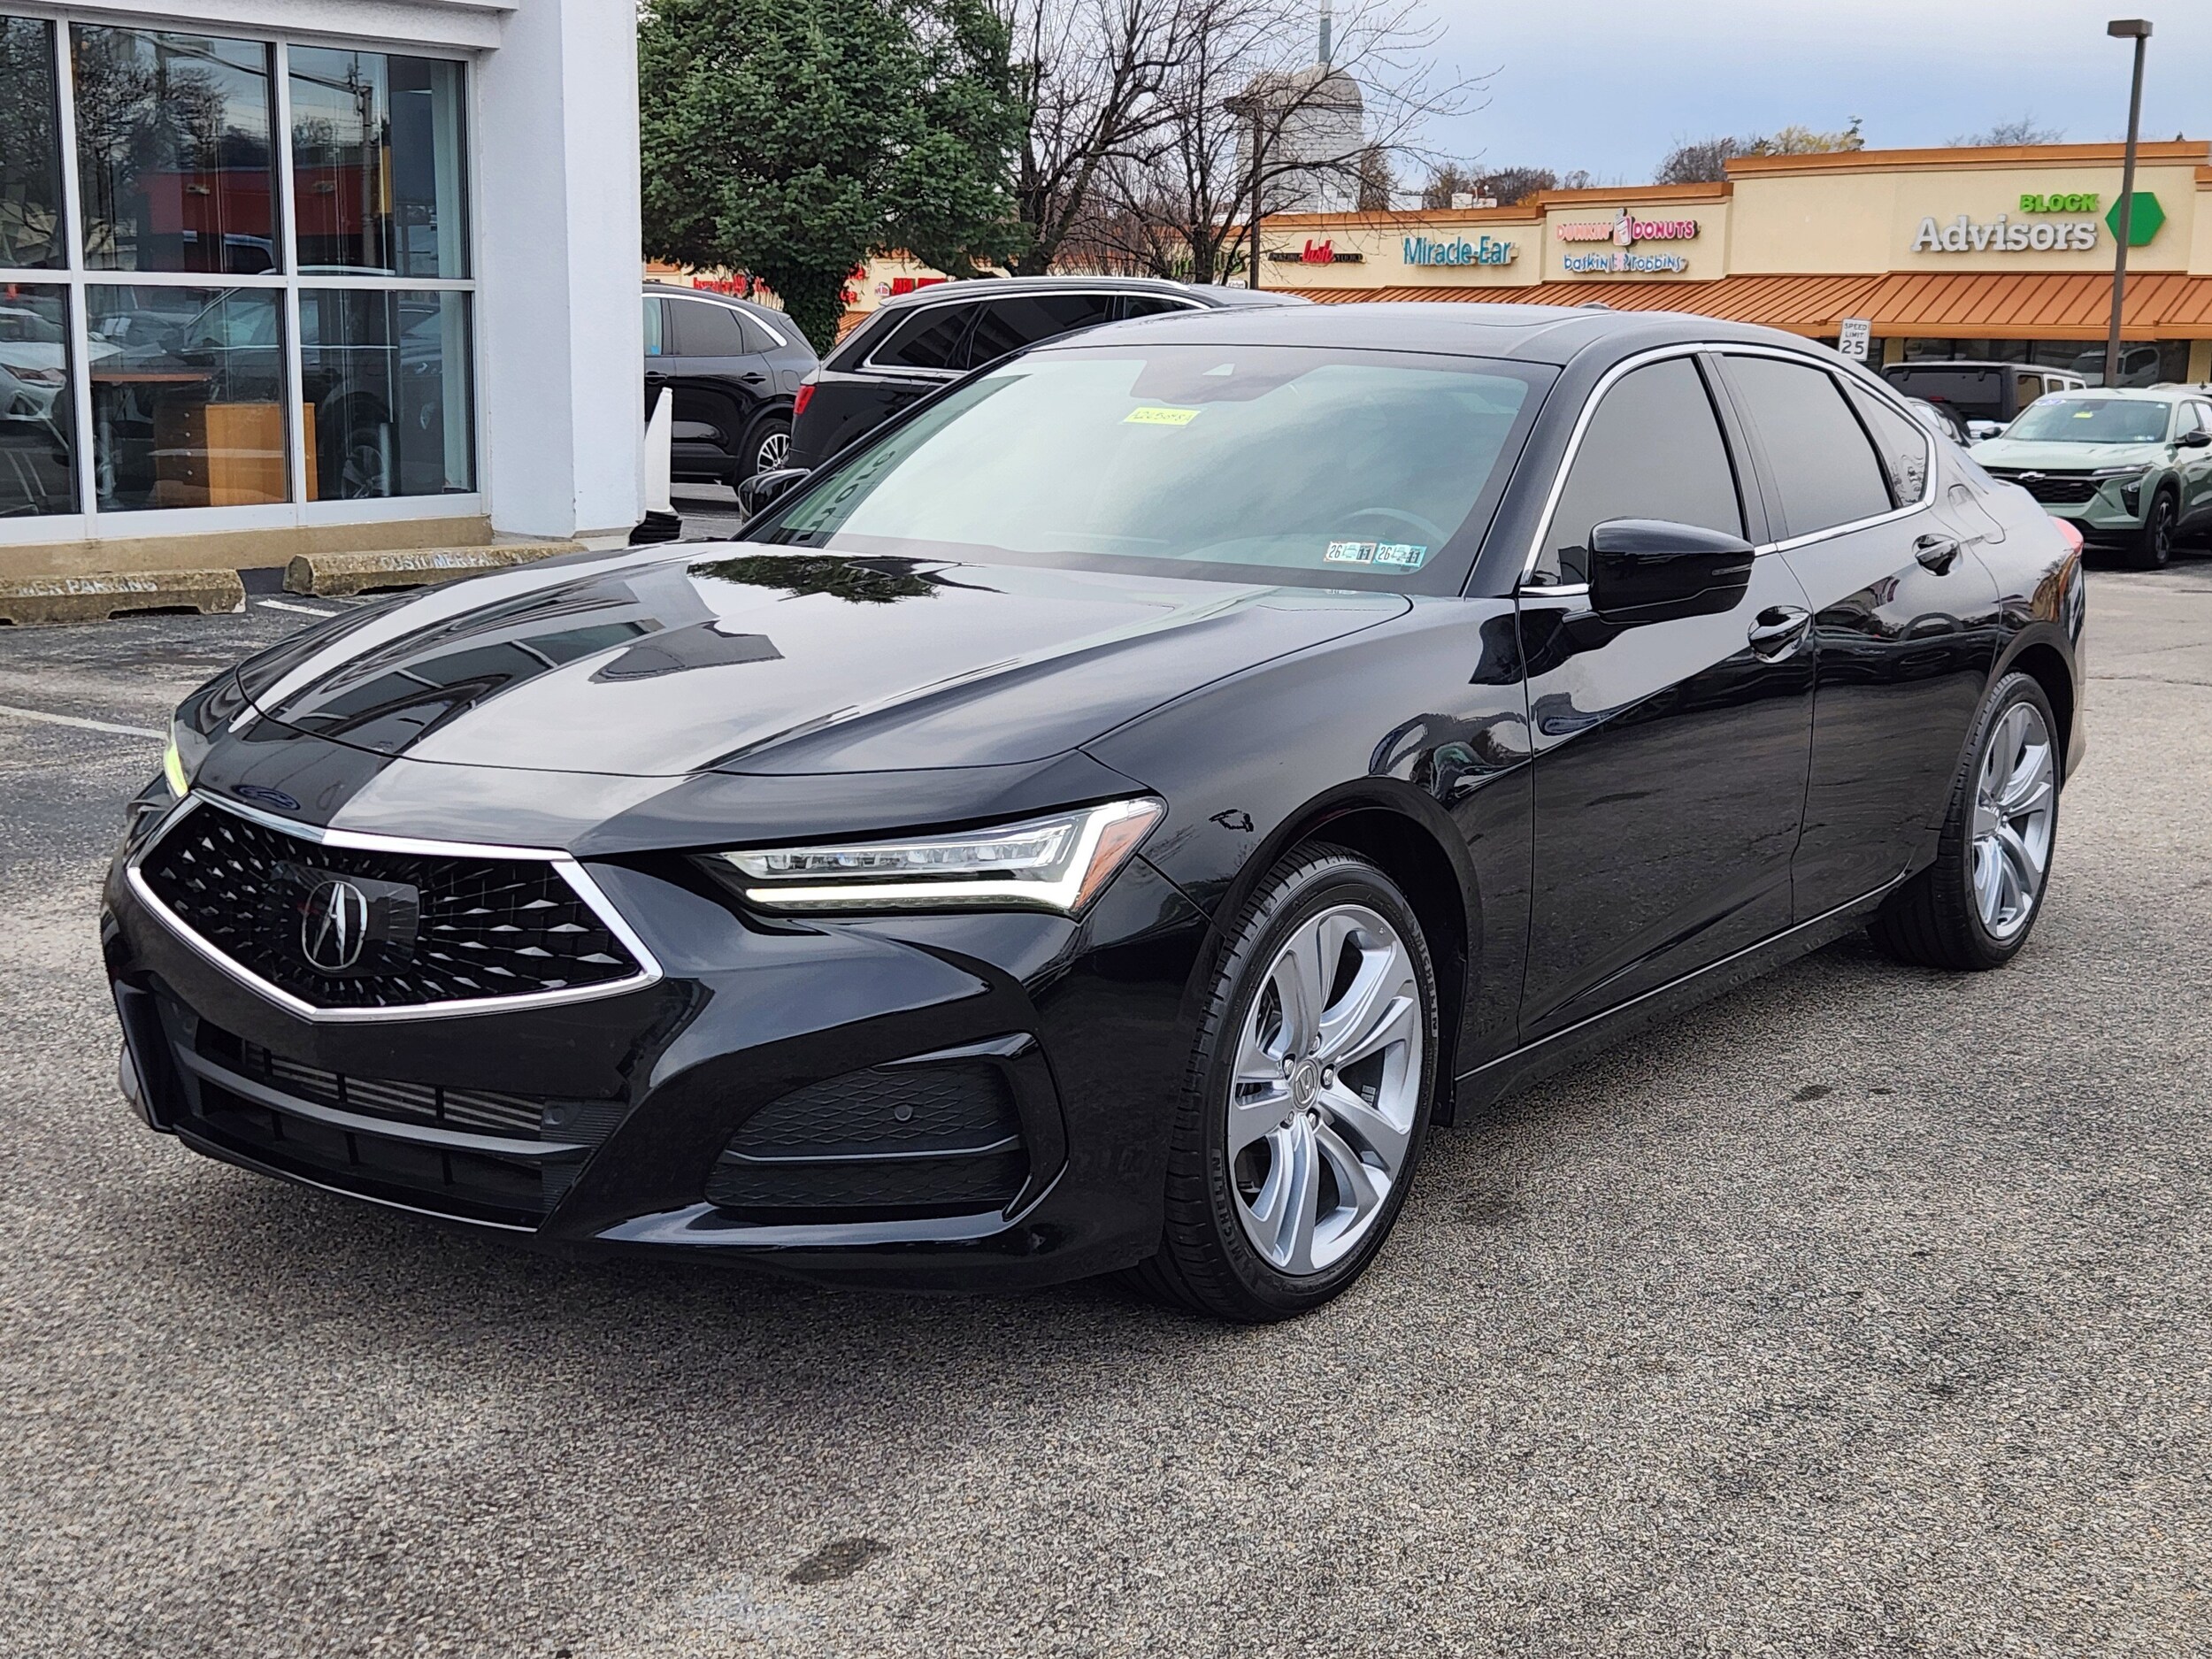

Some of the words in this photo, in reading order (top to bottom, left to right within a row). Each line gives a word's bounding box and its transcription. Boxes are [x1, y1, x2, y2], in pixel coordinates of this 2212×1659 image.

[2019, 193, 2099, 213] BLOCK
[1632, 220, 1695, 241] DONUTS
[1911, 213, 2098, 252] Advisors
[1403, 235, 1512, 265] Miracle-Ear
[1563, 254, 1609, 270] baskin
[1631, 254, 1684, 271] robbins
[1841, 340, 1864, 355] 25
[1328, 545, 1342, 558] 26
[1356, 549, 1371, 560] 11
[1378, 547, 1390, 560] 26
[1415, 933, 1440, 1031] MICHELIN
[1211, 1156, 1245, 1263] MICHELIN
